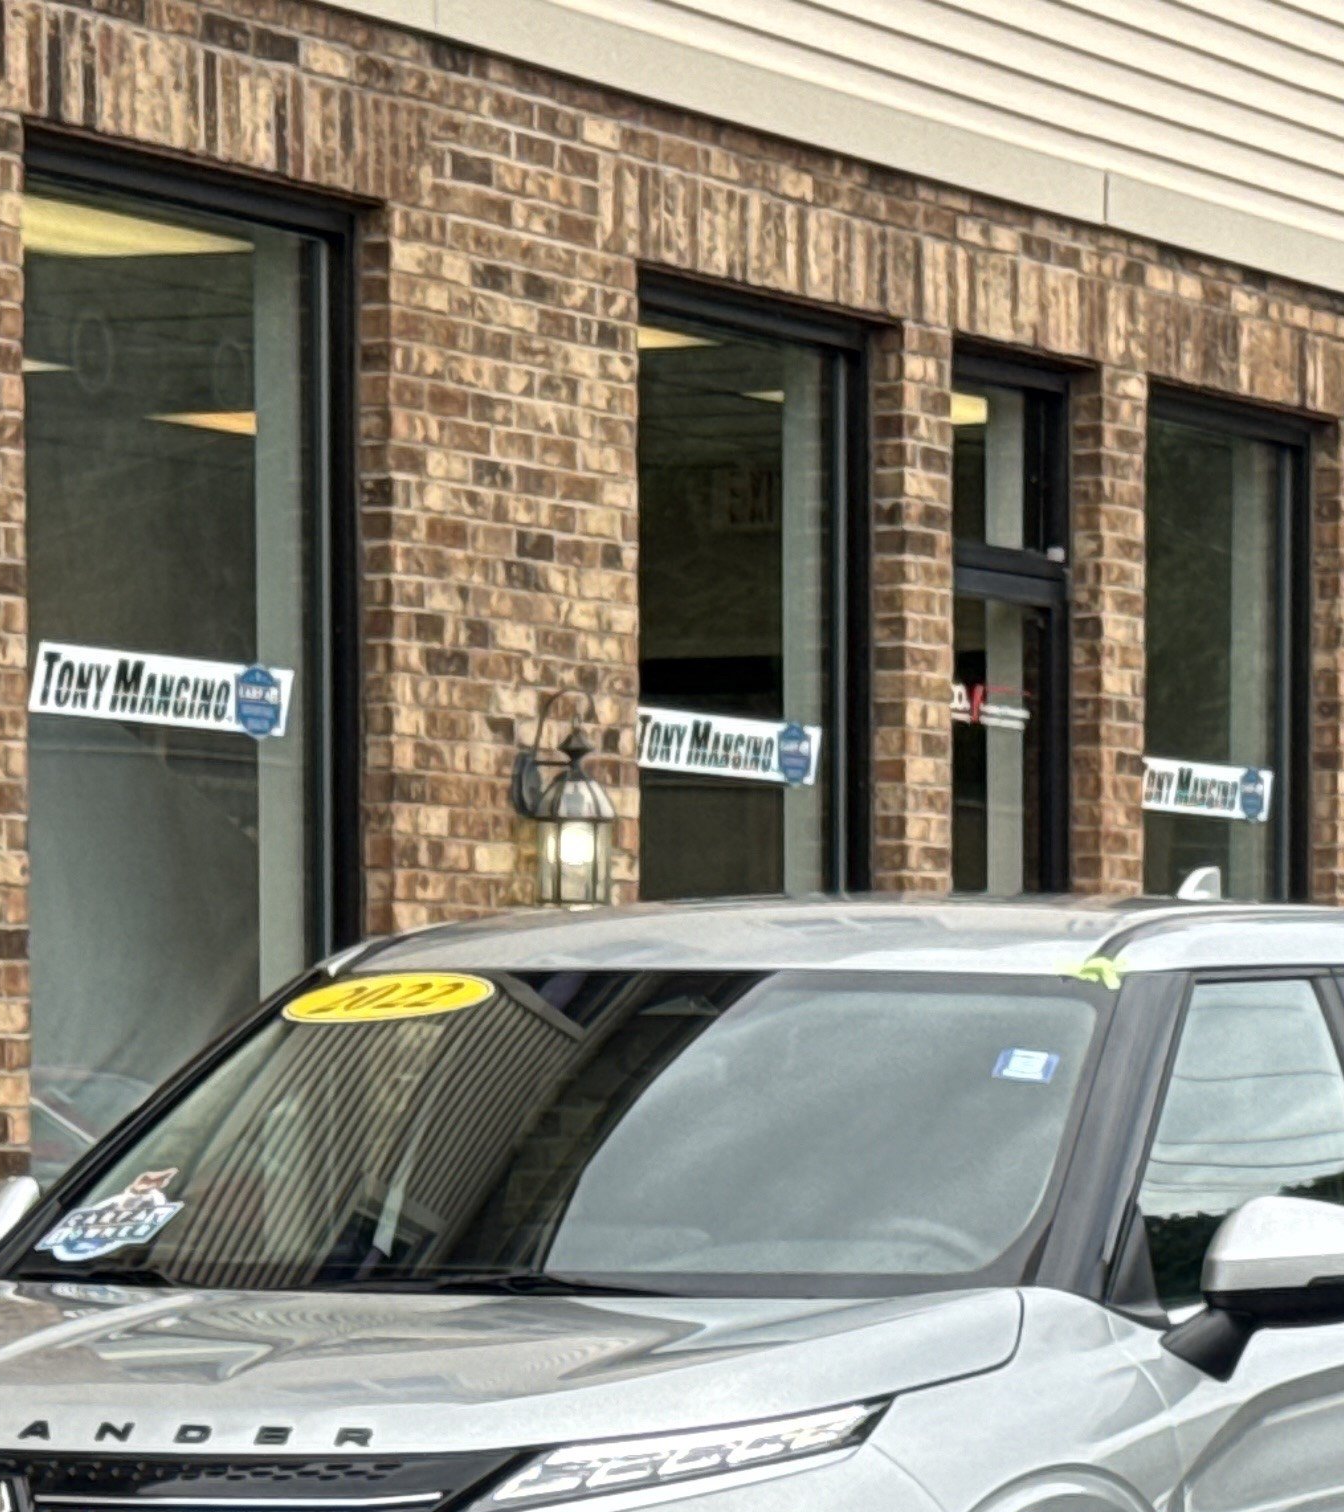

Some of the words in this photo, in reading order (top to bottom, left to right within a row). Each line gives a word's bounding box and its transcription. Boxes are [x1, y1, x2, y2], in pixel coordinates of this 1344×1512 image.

[40, 651, 111, 710] TONY
[109, 658, 230, 722] MANGINO
[638, 715, 687, 764] TONY
[1144, 768, 1174, 805] ONY
[307, 982, 464, 1014] 2022
